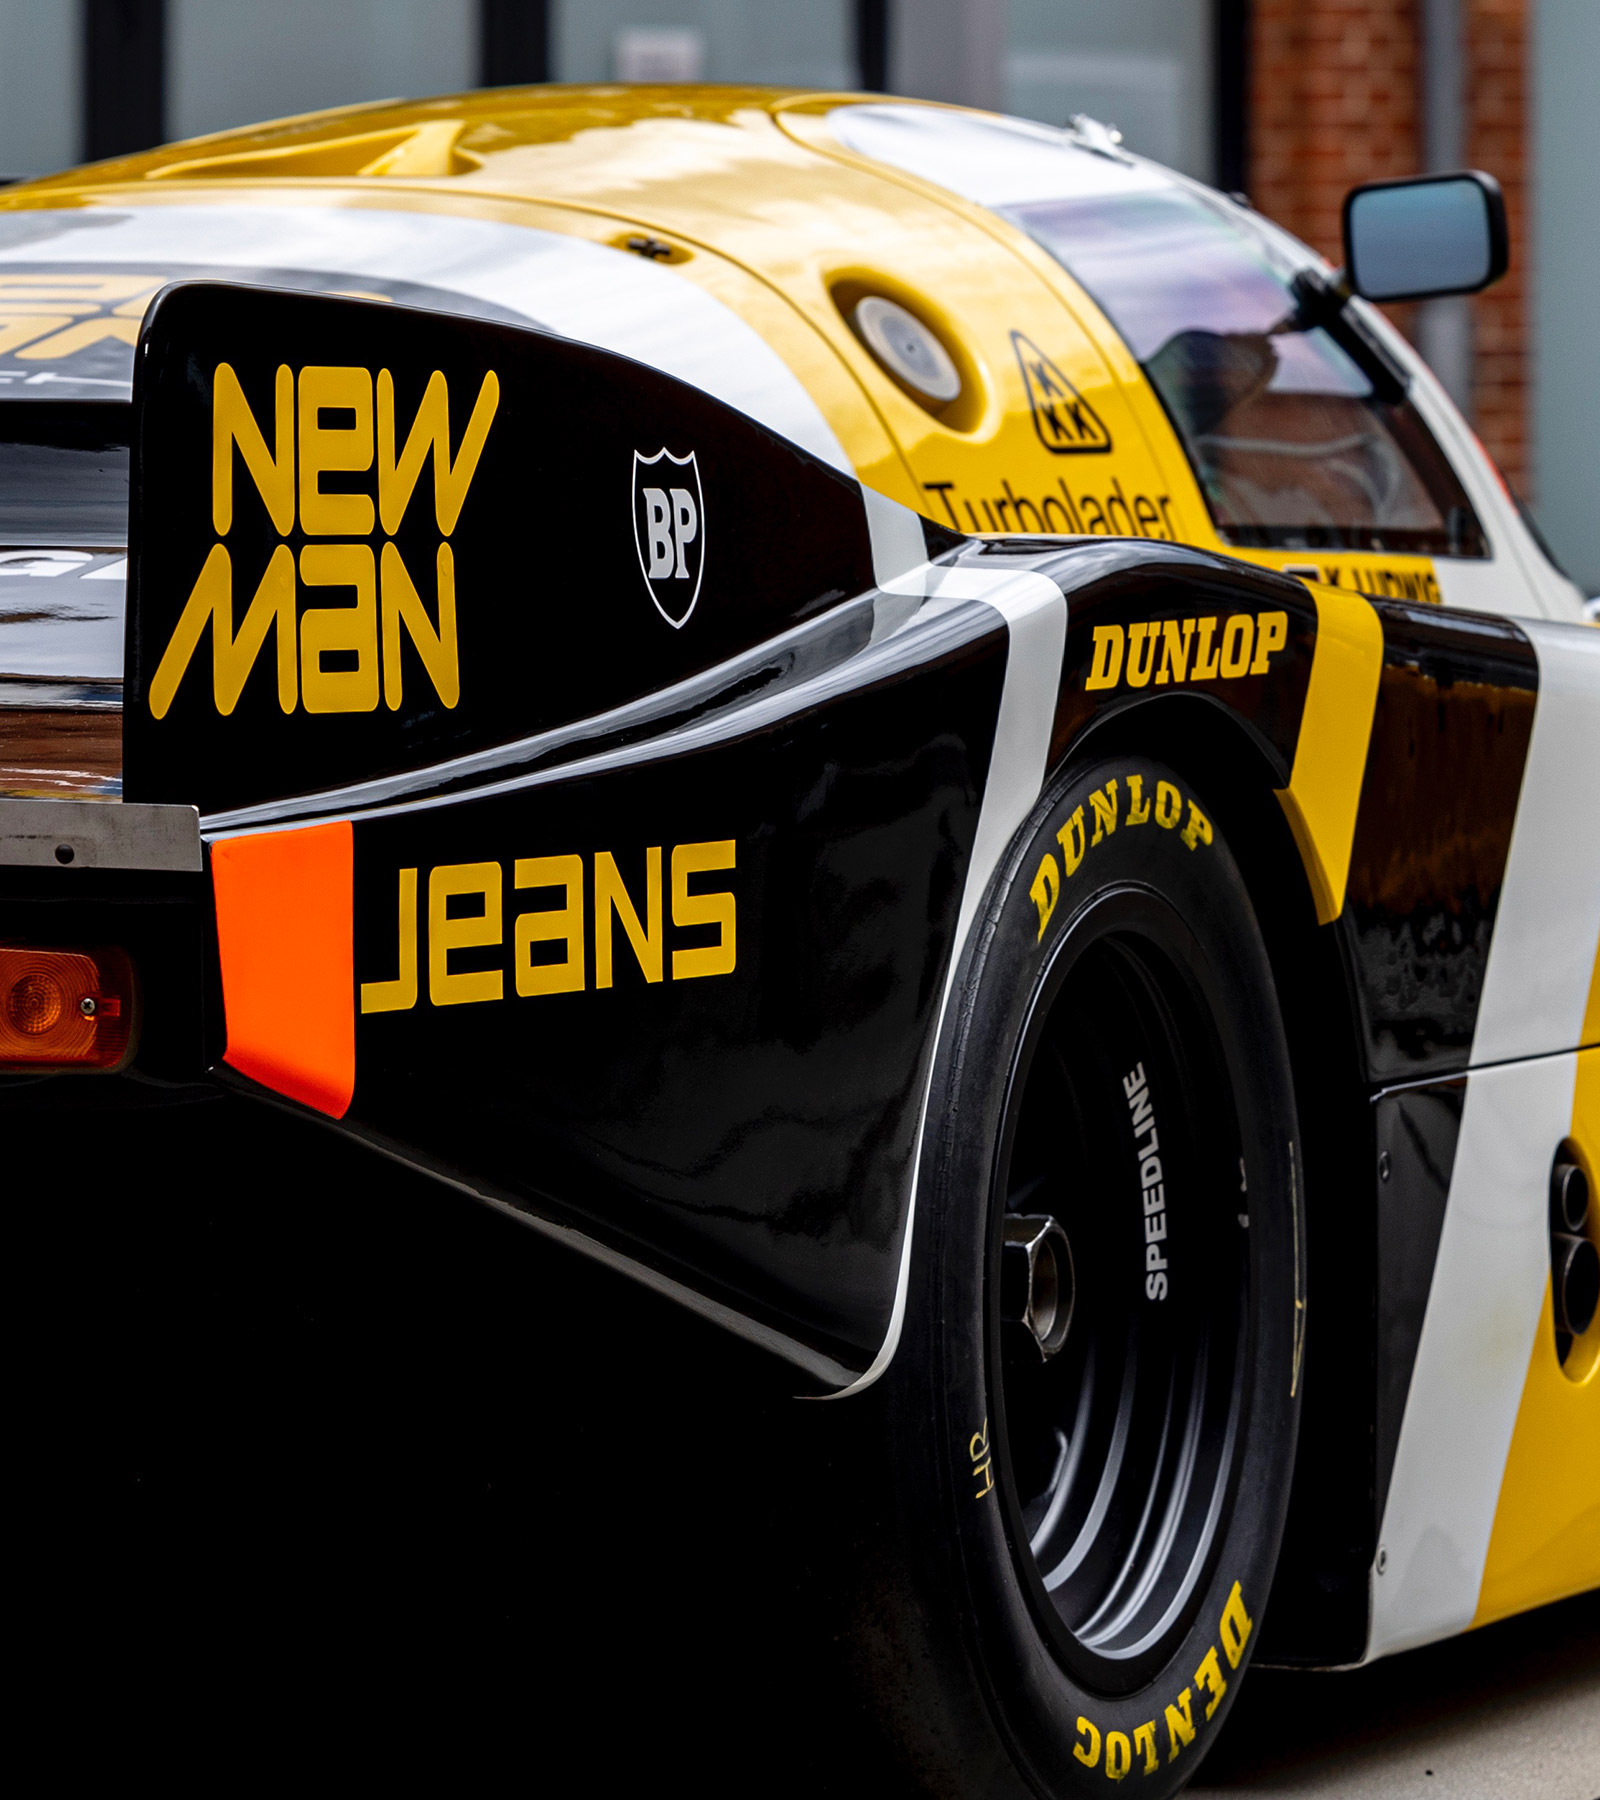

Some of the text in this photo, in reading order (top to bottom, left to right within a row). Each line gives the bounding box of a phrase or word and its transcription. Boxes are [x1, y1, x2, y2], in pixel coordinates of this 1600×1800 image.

[643, 487, 698, 580] BP
[923, 476, 1178, 542] Turbolader
[1085, 611, 1288, 691] DUNLOP
[1029, 774, 1214, 943] DUNLOP
[1122, 1061, 1168, 1301] SPEEDLINE
[1072, 1579, 1253, 1784] DENLOC
